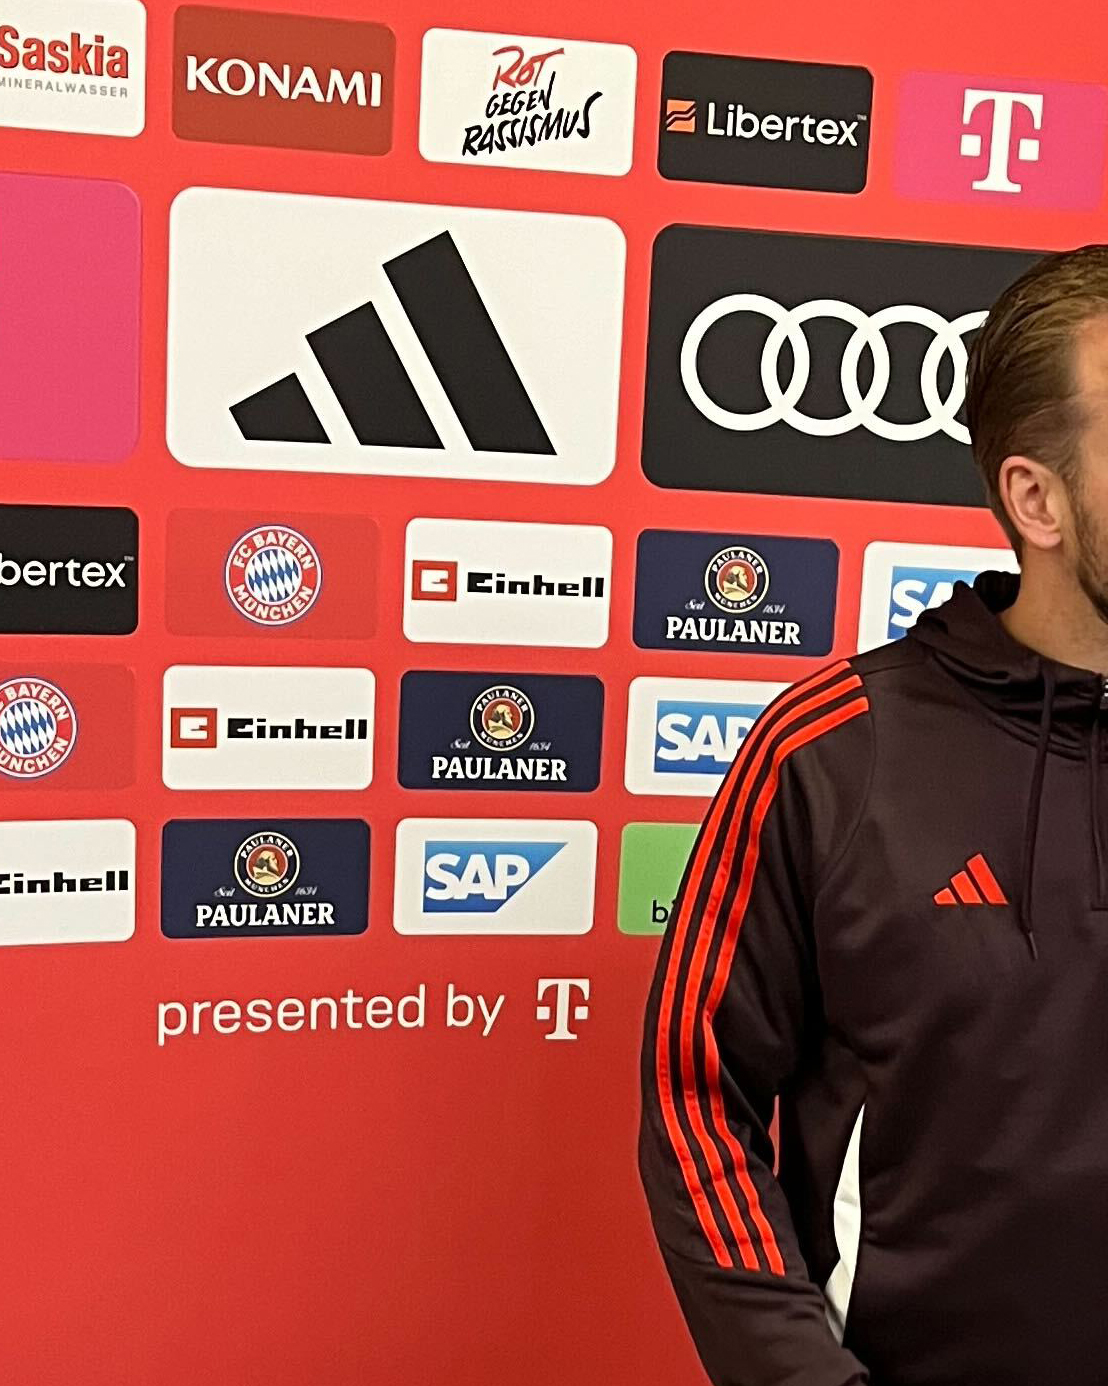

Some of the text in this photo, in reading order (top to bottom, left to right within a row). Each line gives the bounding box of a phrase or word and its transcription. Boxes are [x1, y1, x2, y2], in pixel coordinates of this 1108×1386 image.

[0, 25, 128, 78] Saskia
[493, 46, 565, 90] ROT
[187, 56, 382, 107] KONAMI
[485, 71, 556, 119] GEGEN
[461, 92, 603, 156] RASSISMUS
[233, 532, 315, 570] FC BAYERN
[712, 551, 763, 575] PAULANER
[466, 571, 605, 598] Einhell
[666, 616, 801, 645] PAULANER
[4, 684, 70, 721] BAYERN
[477, 690, 529, 712] PAULANER
[227, 718, 367, 740] Einhell
[657, 713, 756, 762] SAP
[431, 756, 567, 781] PAULANER
[241, 836, 293, 858] PAULANER
[424, 852, 530, 901] SAP
[196, 903, 335, 928] PAULANER
[158, 984, 426, 1046] presented
[446, 984, 505, 1037] by
